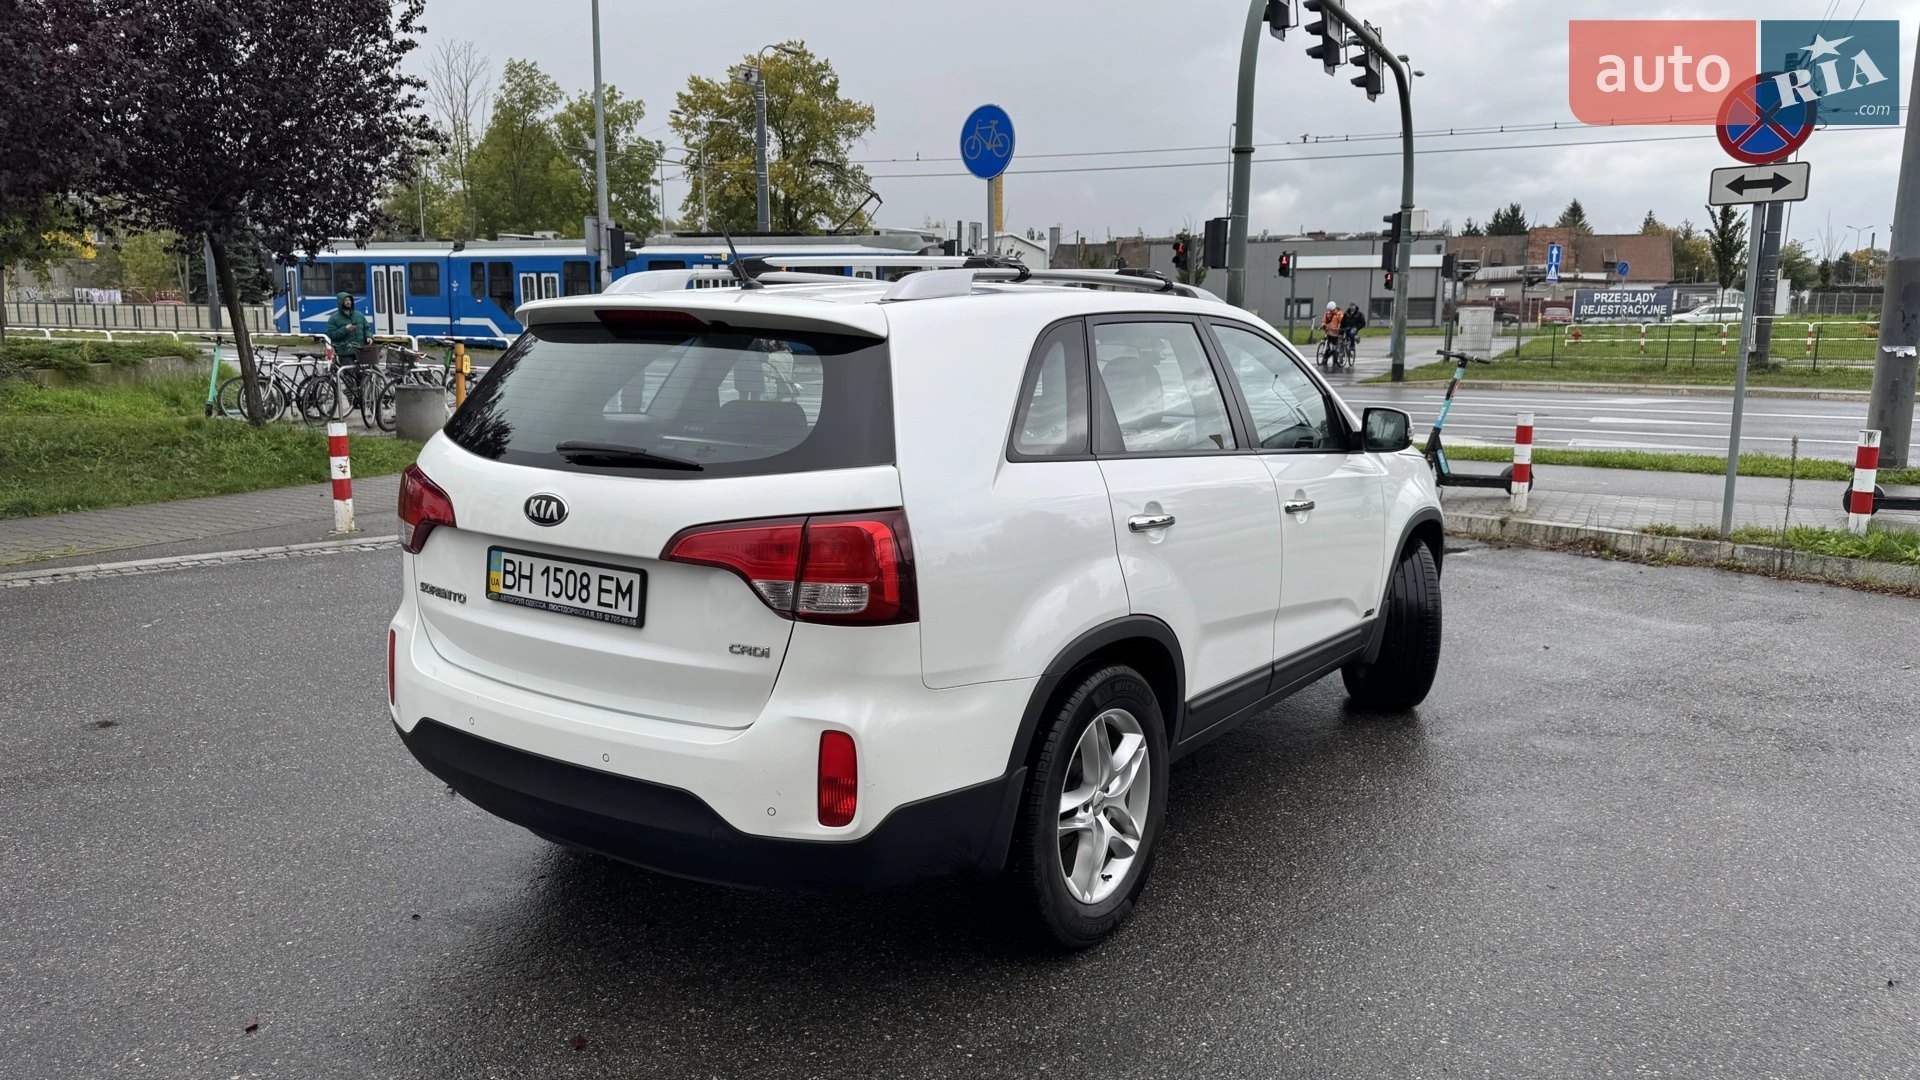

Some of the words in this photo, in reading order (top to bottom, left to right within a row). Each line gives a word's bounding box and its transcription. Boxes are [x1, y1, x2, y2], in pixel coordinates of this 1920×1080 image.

[1593, 293, 1657, 304] PRZEGLĄDY
[1580, 305, 1667, 315] REJESTRACYJNE
[528, 499, 559, 520] KIA
[490, 577, 500, 587] UA
[502, 558, 533, 594] BH
[540, 565, 591, 603] 1508
[597, 574, 634, 612] EM
